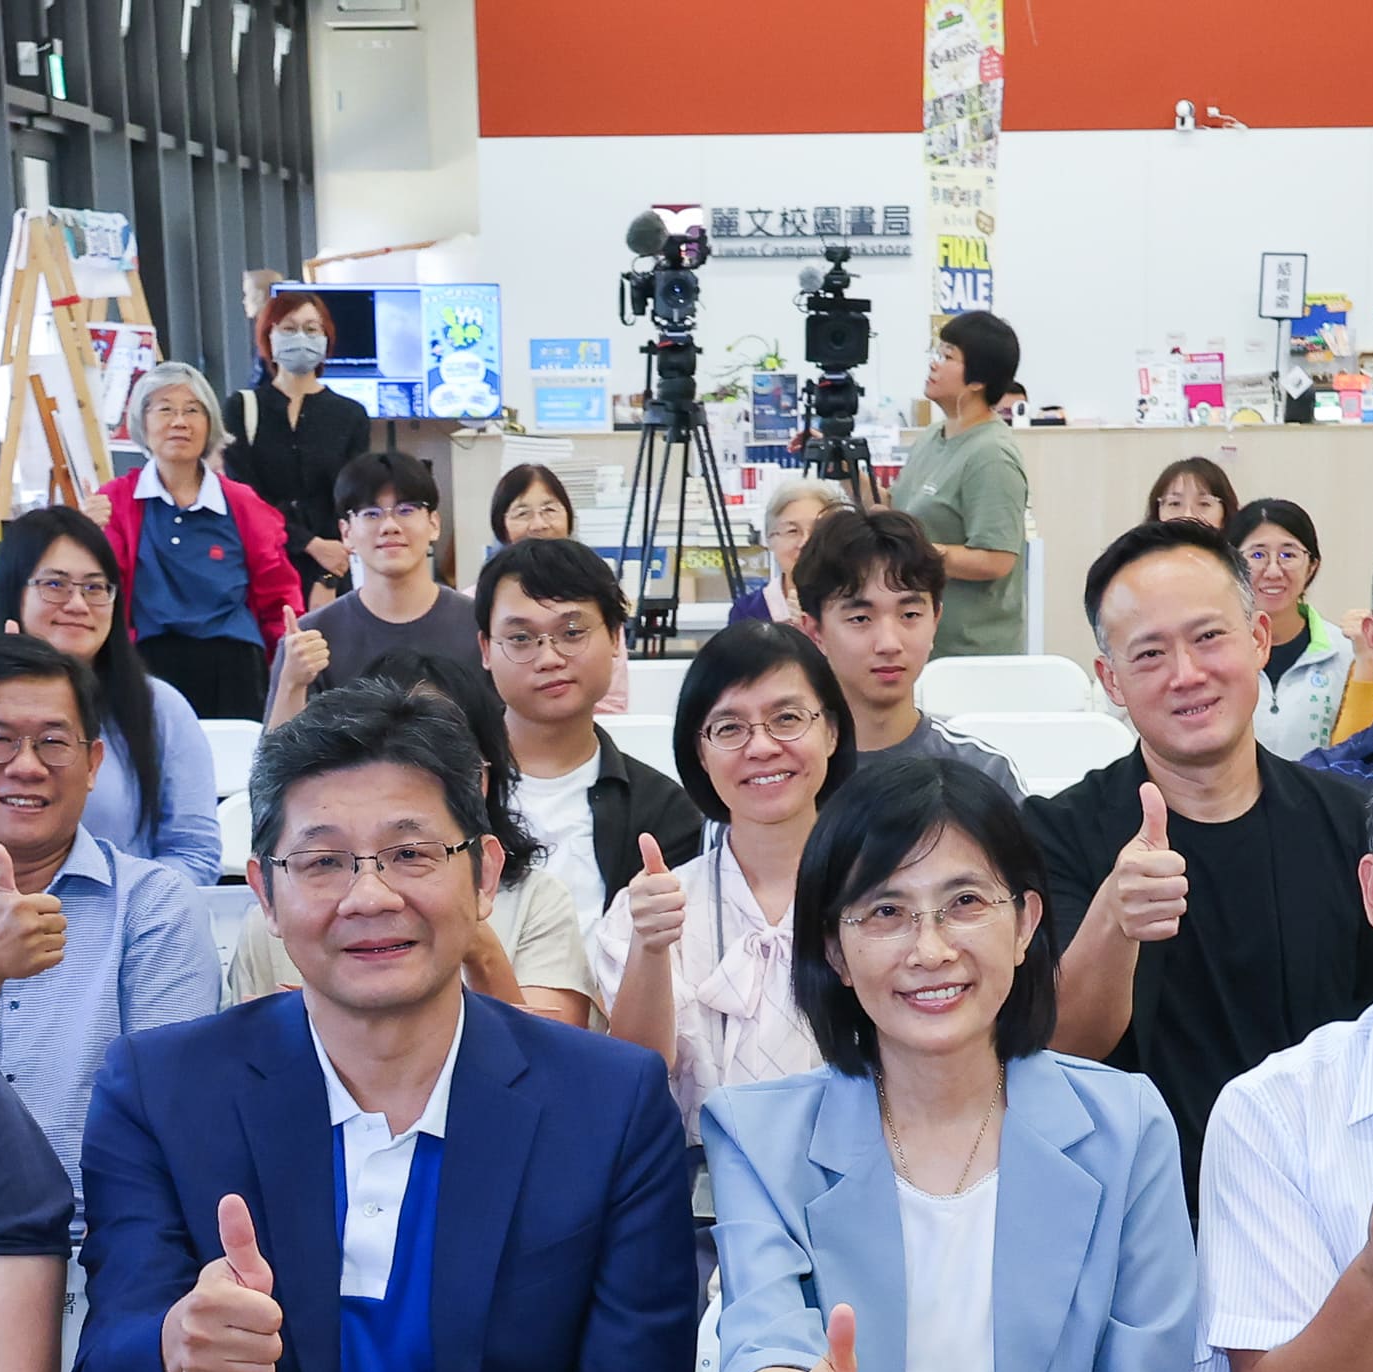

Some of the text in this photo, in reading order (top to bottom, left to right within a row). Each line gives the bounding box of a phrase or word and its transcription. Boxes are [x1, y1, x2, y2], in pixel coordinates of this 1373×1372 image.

[710, 206, 912, 238] 麗文校園書局
[938, 236, 991, 270] FINAL
[939, 270, 992, 311] SALE
